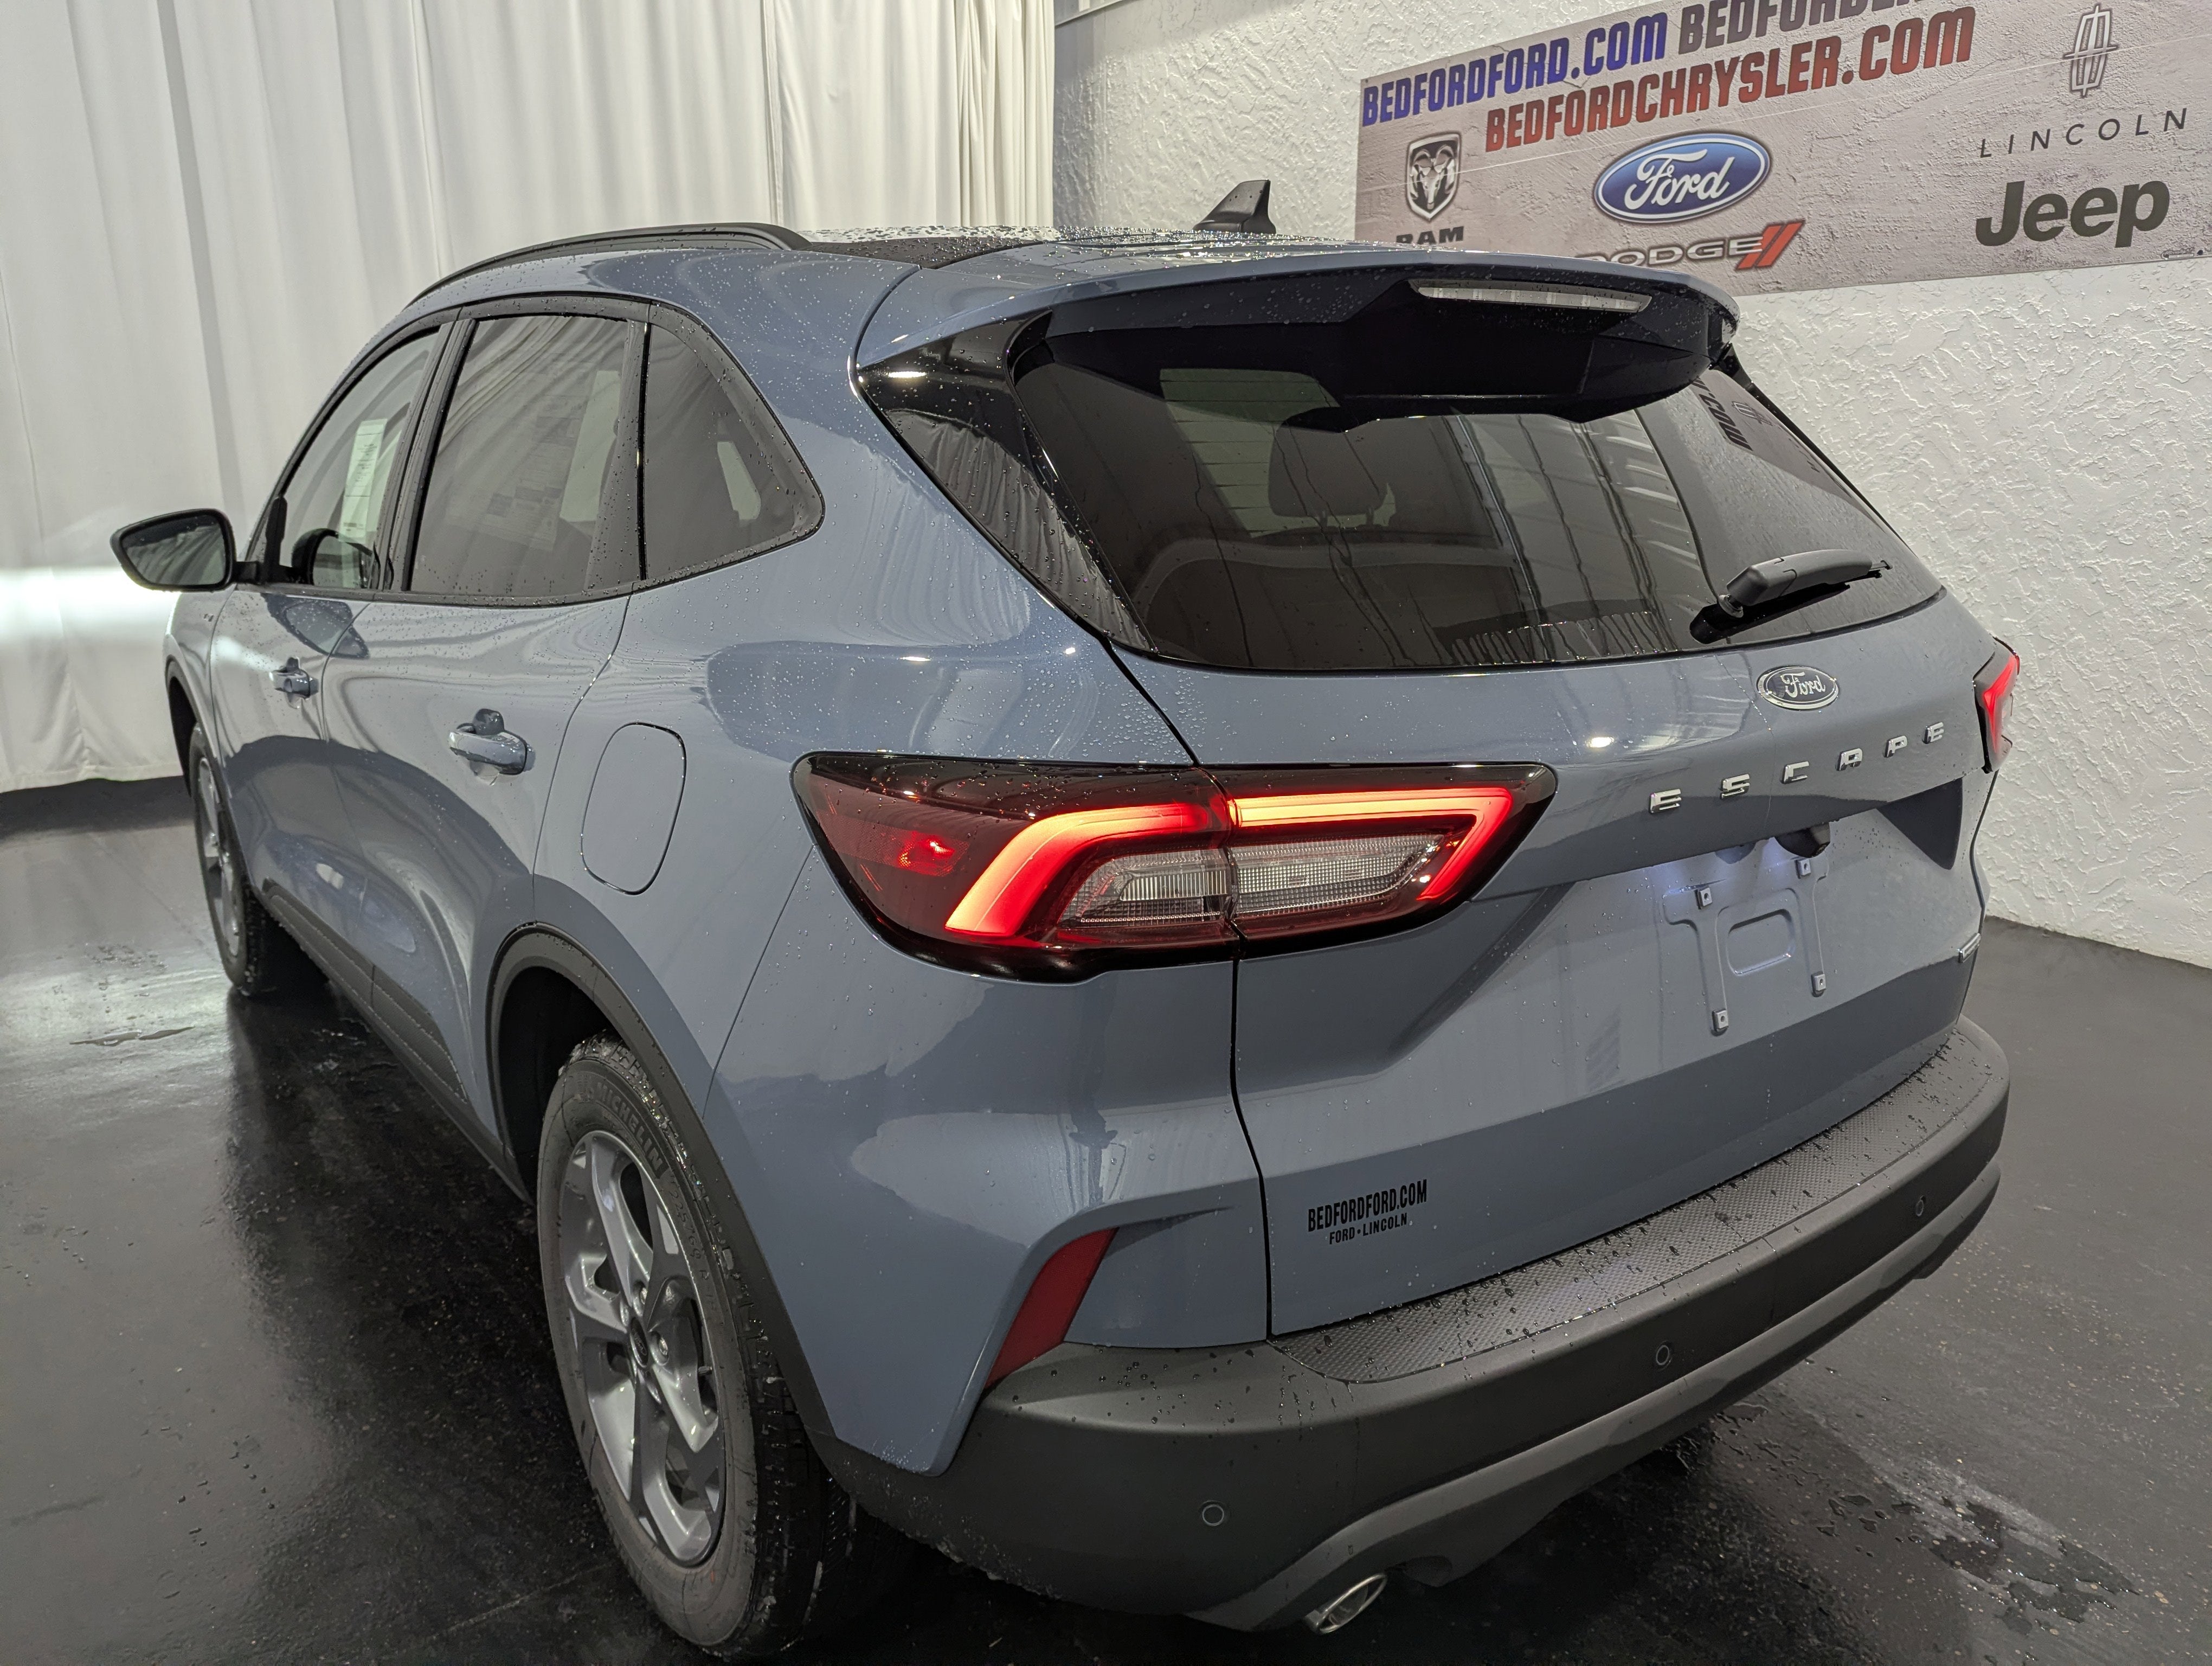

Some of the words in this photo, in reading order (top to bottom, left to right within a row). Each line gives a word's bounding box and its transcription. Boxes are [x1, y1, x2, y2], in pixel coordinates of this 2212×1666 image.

[1362, 12, 1668, 127] BEDFORDFORD.COM
[1485, 6, 1976, 152] BEDFORDCHRYSLER.COM
[1979, 108, 2187, 158] LINCOLN
[1624, 148, 1735, 210] Ford
[1975, 180, 2170, 248] Jeep
[1780, 671, 1826, 698] Ford
[1649, 721, 1944, 815] ESCAPE
[1308, 1178, 1427, 1232] BEDFORDFORD.COM
